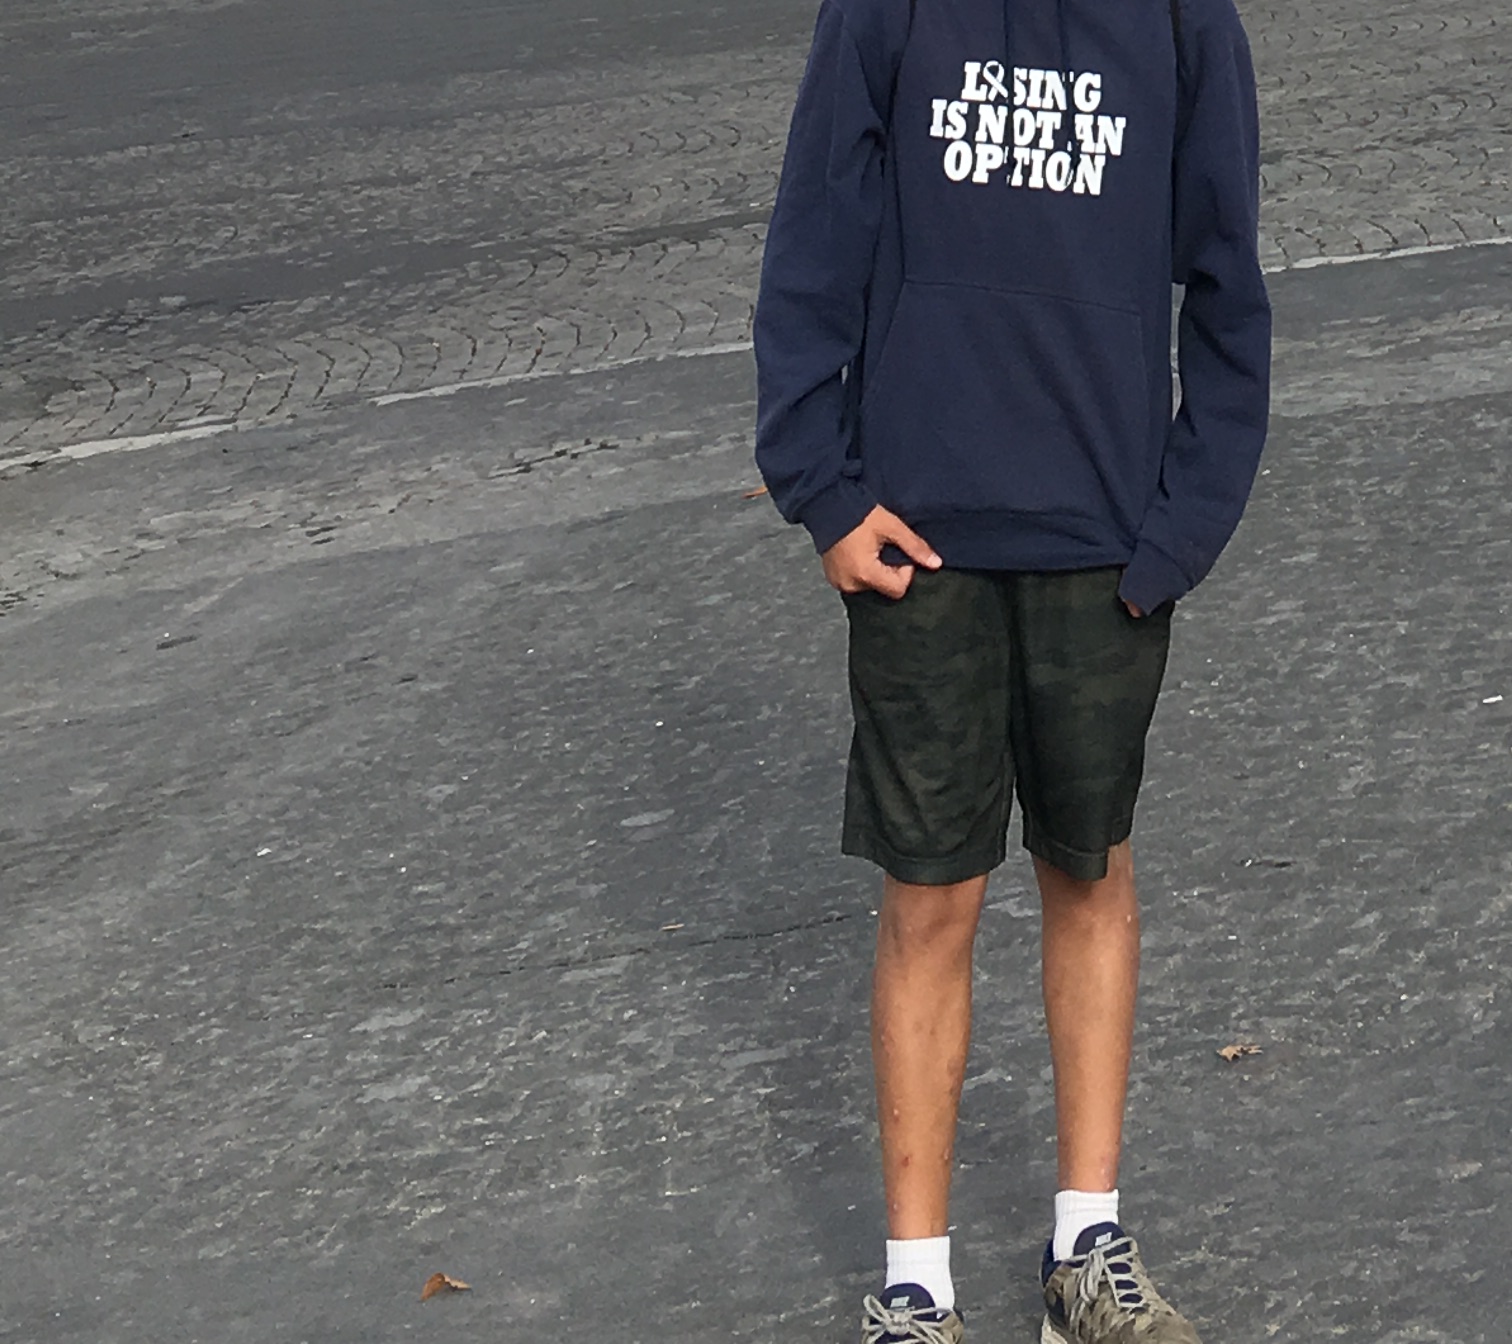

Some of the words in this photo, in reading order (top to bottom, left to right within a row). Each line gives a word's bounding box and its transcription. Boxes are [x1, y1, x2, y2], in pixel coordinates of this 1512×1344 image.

[929, 98, 969, 140] IS
[974, 103, 1062, 150] NOT
[1067, 113, 1127, 156] AN
[943, 140, 1106, 196] OPTION
